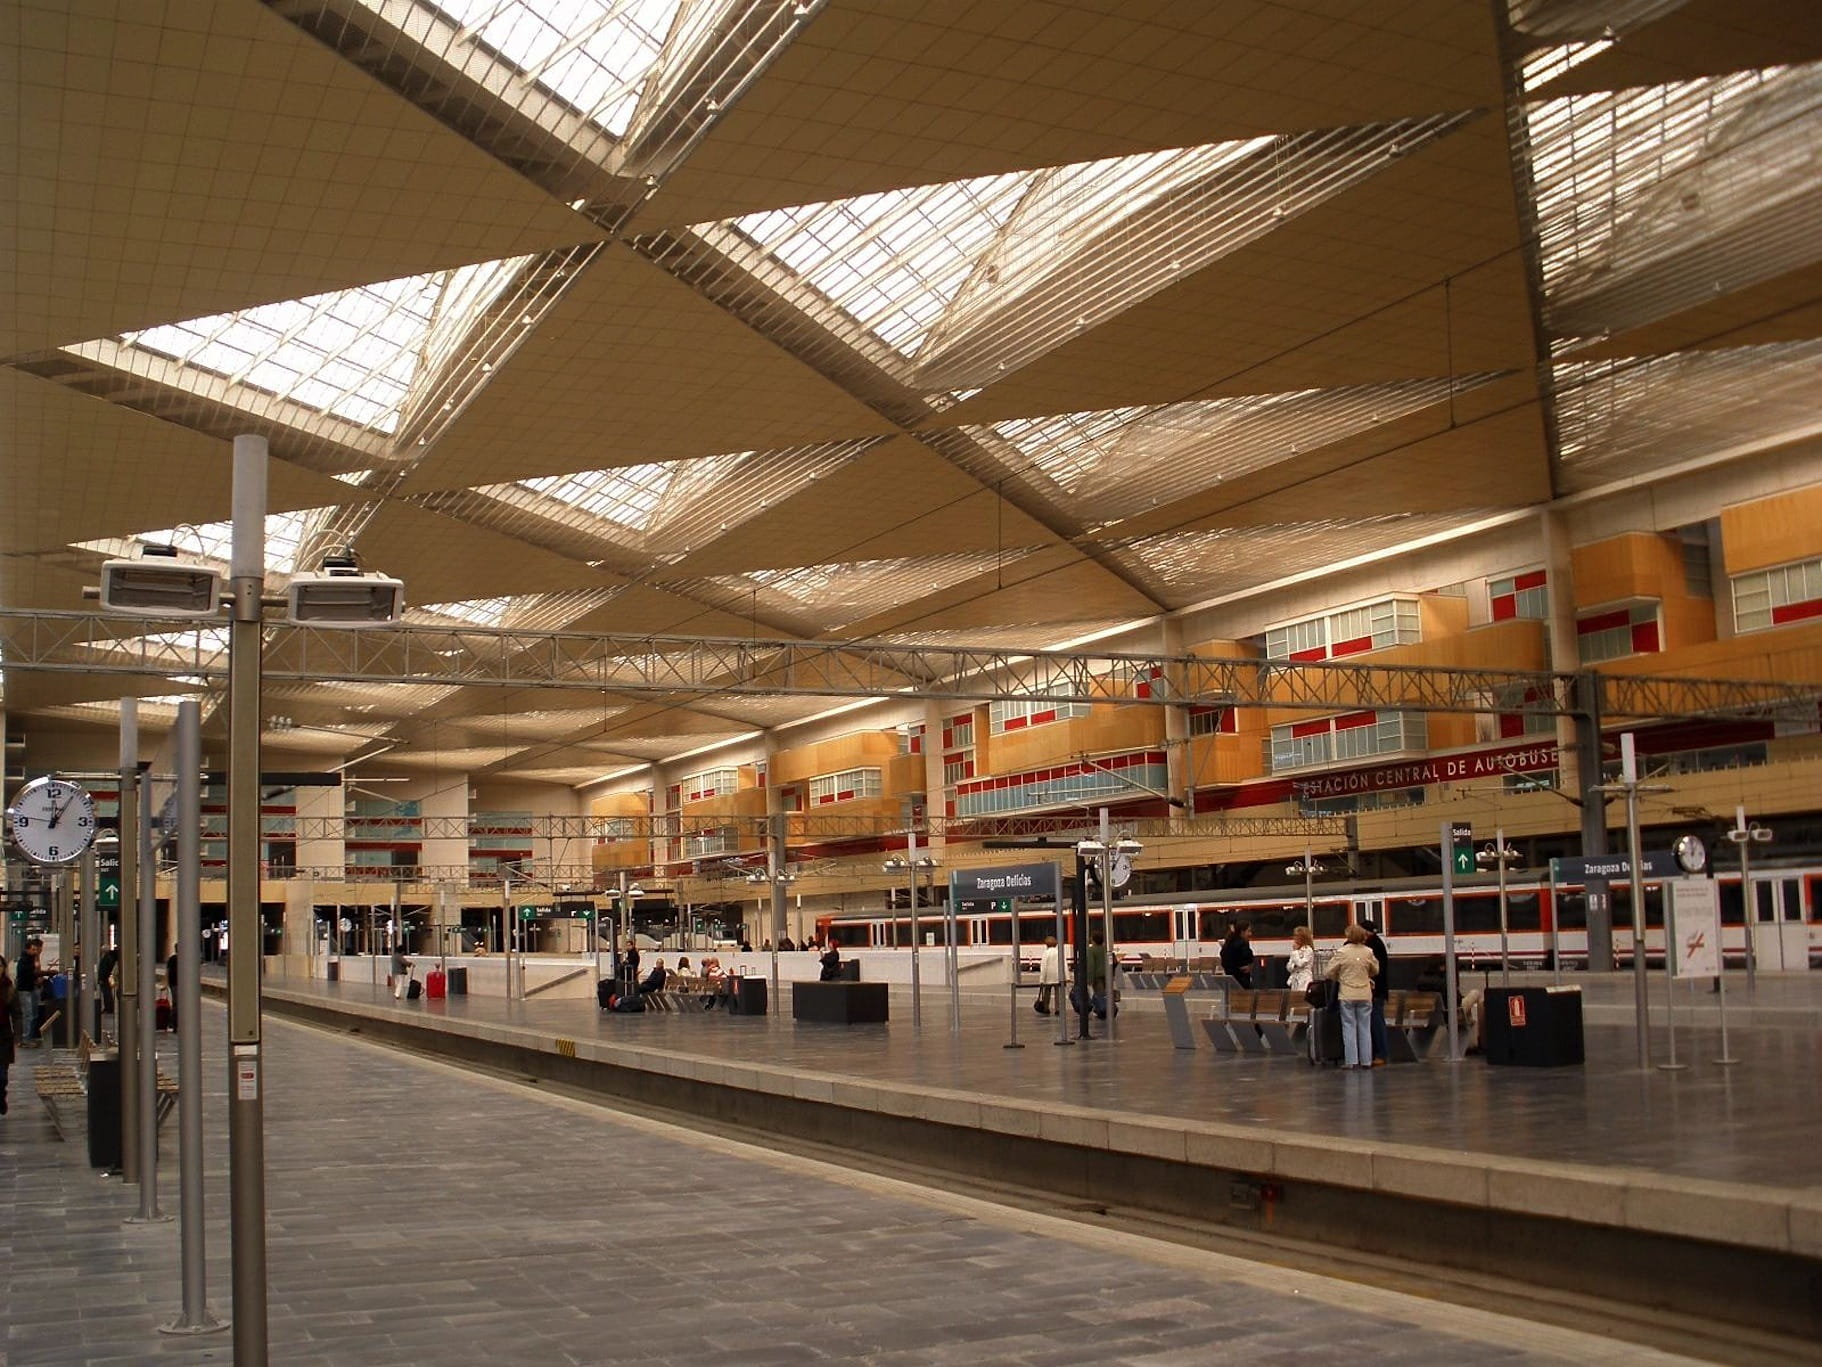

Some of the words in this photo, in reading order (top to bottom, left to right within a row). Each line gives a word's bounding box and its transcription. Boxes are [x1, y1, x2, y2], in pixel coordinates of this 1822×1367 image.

[1375, 764, 1439, 786] CENTRAL
[1447, 760, 1467, 776] DE
[47, 788, 62, 798] 12
[19, 816, 29, 827] 9
[78, 817, 88, 827] 3
[48, 846, 59, 856] 6
[1584, 863, 1620, 875] Zaragoza
[976, 877, 1005, 891] Zaragoza
[1006, 873, 1032, 888] Delicias
[990, 901, 997, 910] P
